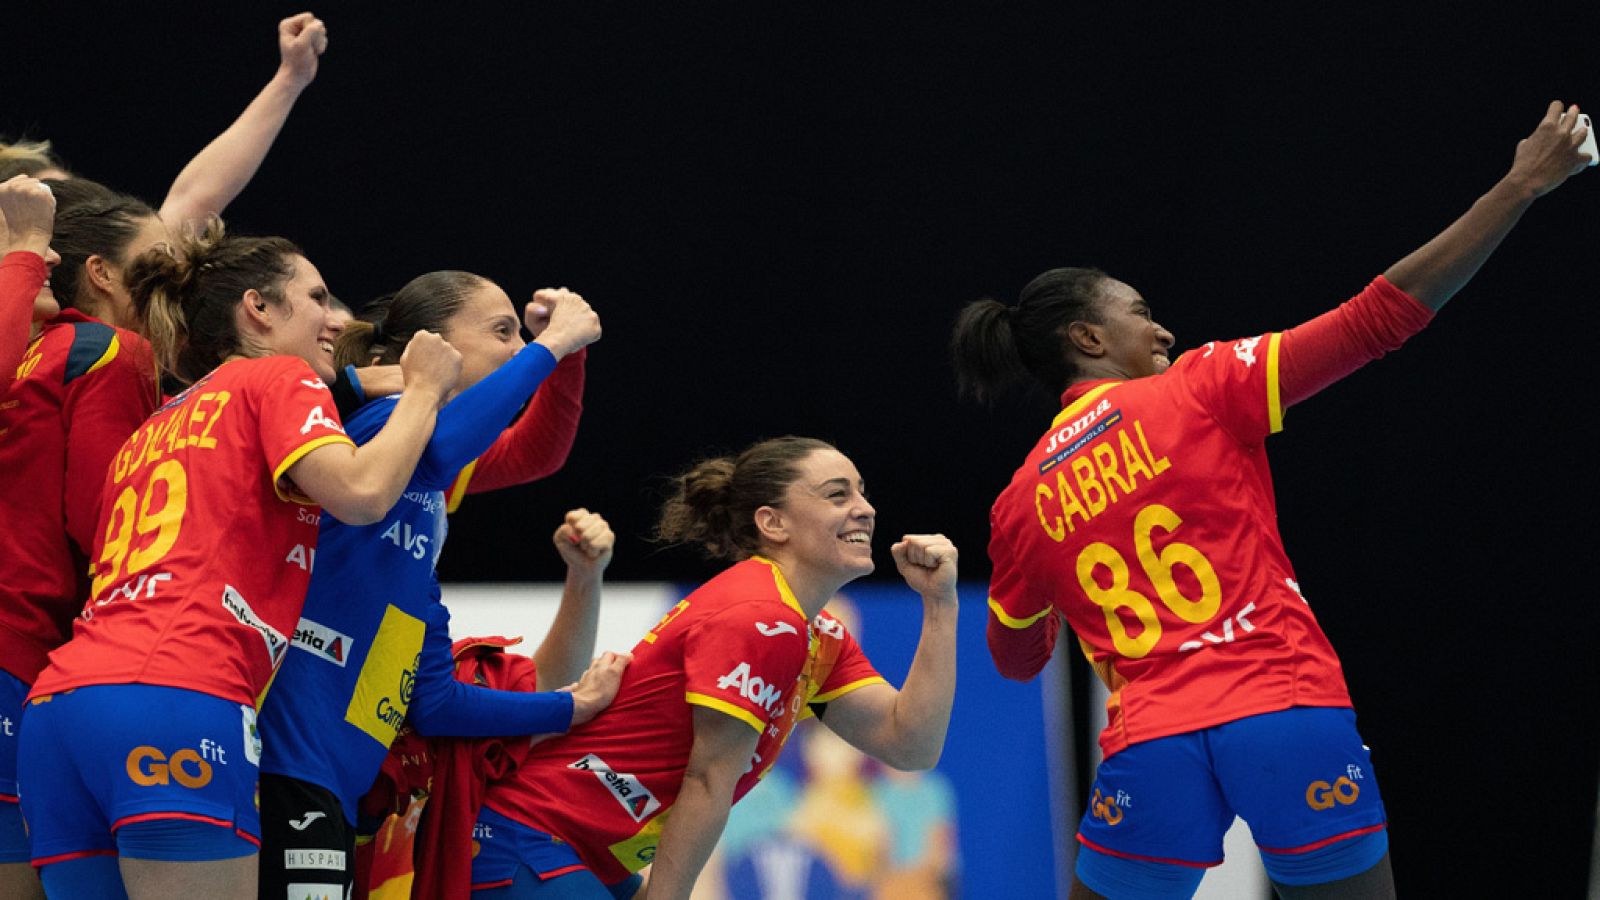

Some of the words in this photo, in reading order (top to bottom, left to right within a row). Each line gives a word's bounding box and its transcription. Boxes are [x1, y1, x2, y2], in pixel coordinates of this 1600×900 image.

[1035, 420, 1172, 543] CABRAL
[88, 458, 187, 601] 99
[1076, 503, 1222, 659] 86
[126, 745, 213, 789] GO
[200, 738, 227, 765] fit
[1116, 789, 1132, 808] fit
[1306, 776, 1360, 812] GO
[1346, 763, 1364, 781] fit
